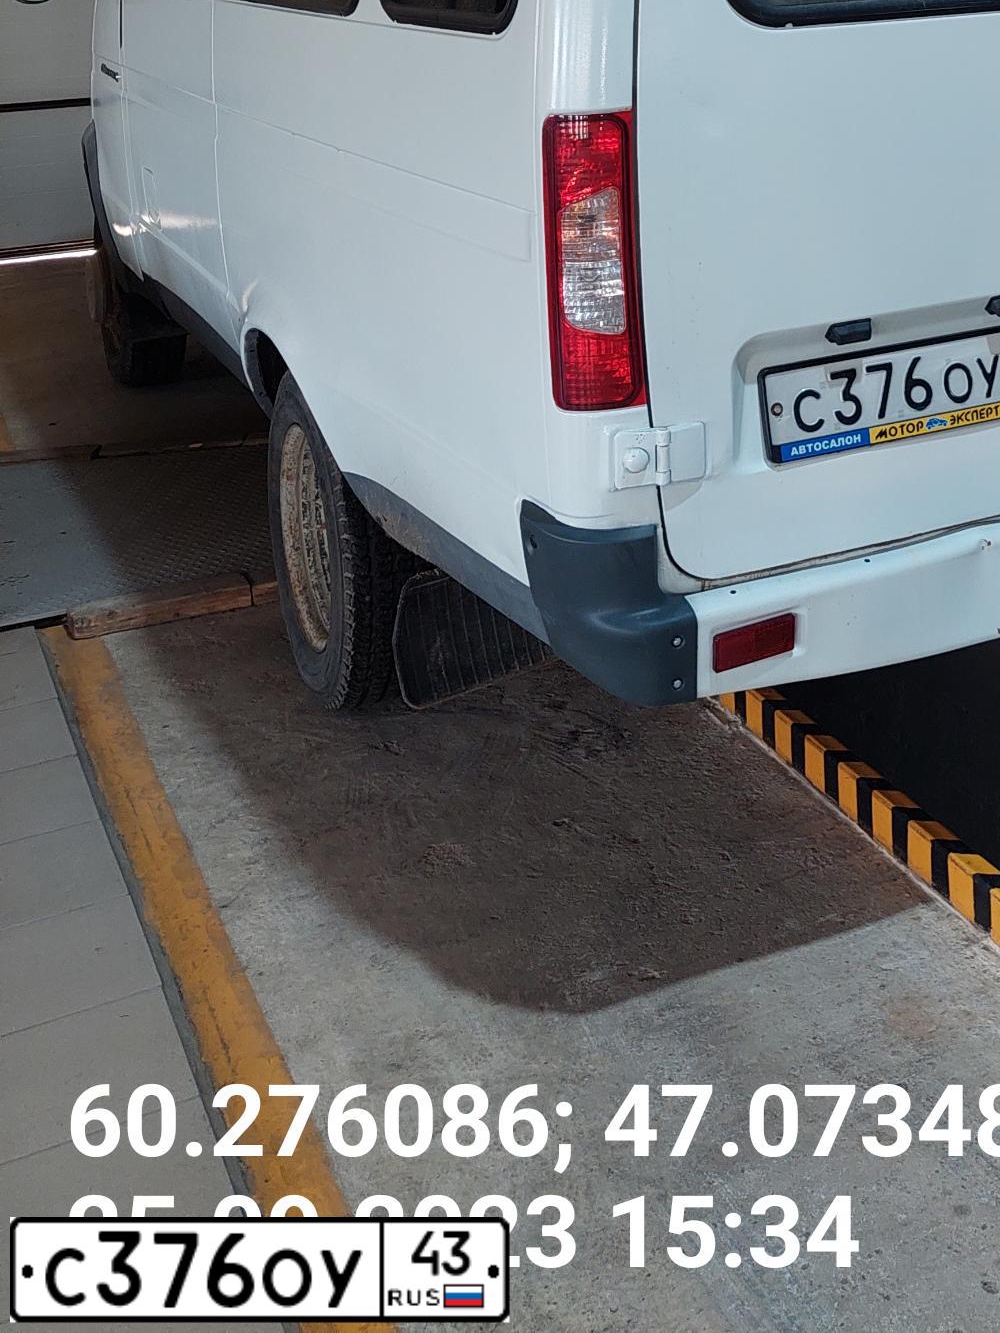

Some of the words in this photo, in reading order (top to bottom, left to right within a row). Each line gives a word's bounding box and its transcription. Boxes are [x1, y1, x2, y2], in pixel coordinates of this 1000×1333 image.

[790, 433, 862, 457] АВТОСАЛОН
[875, 420, 924, 441] МОТОР
[950, 404, 1000, 426] ЭКСПЕРТ
